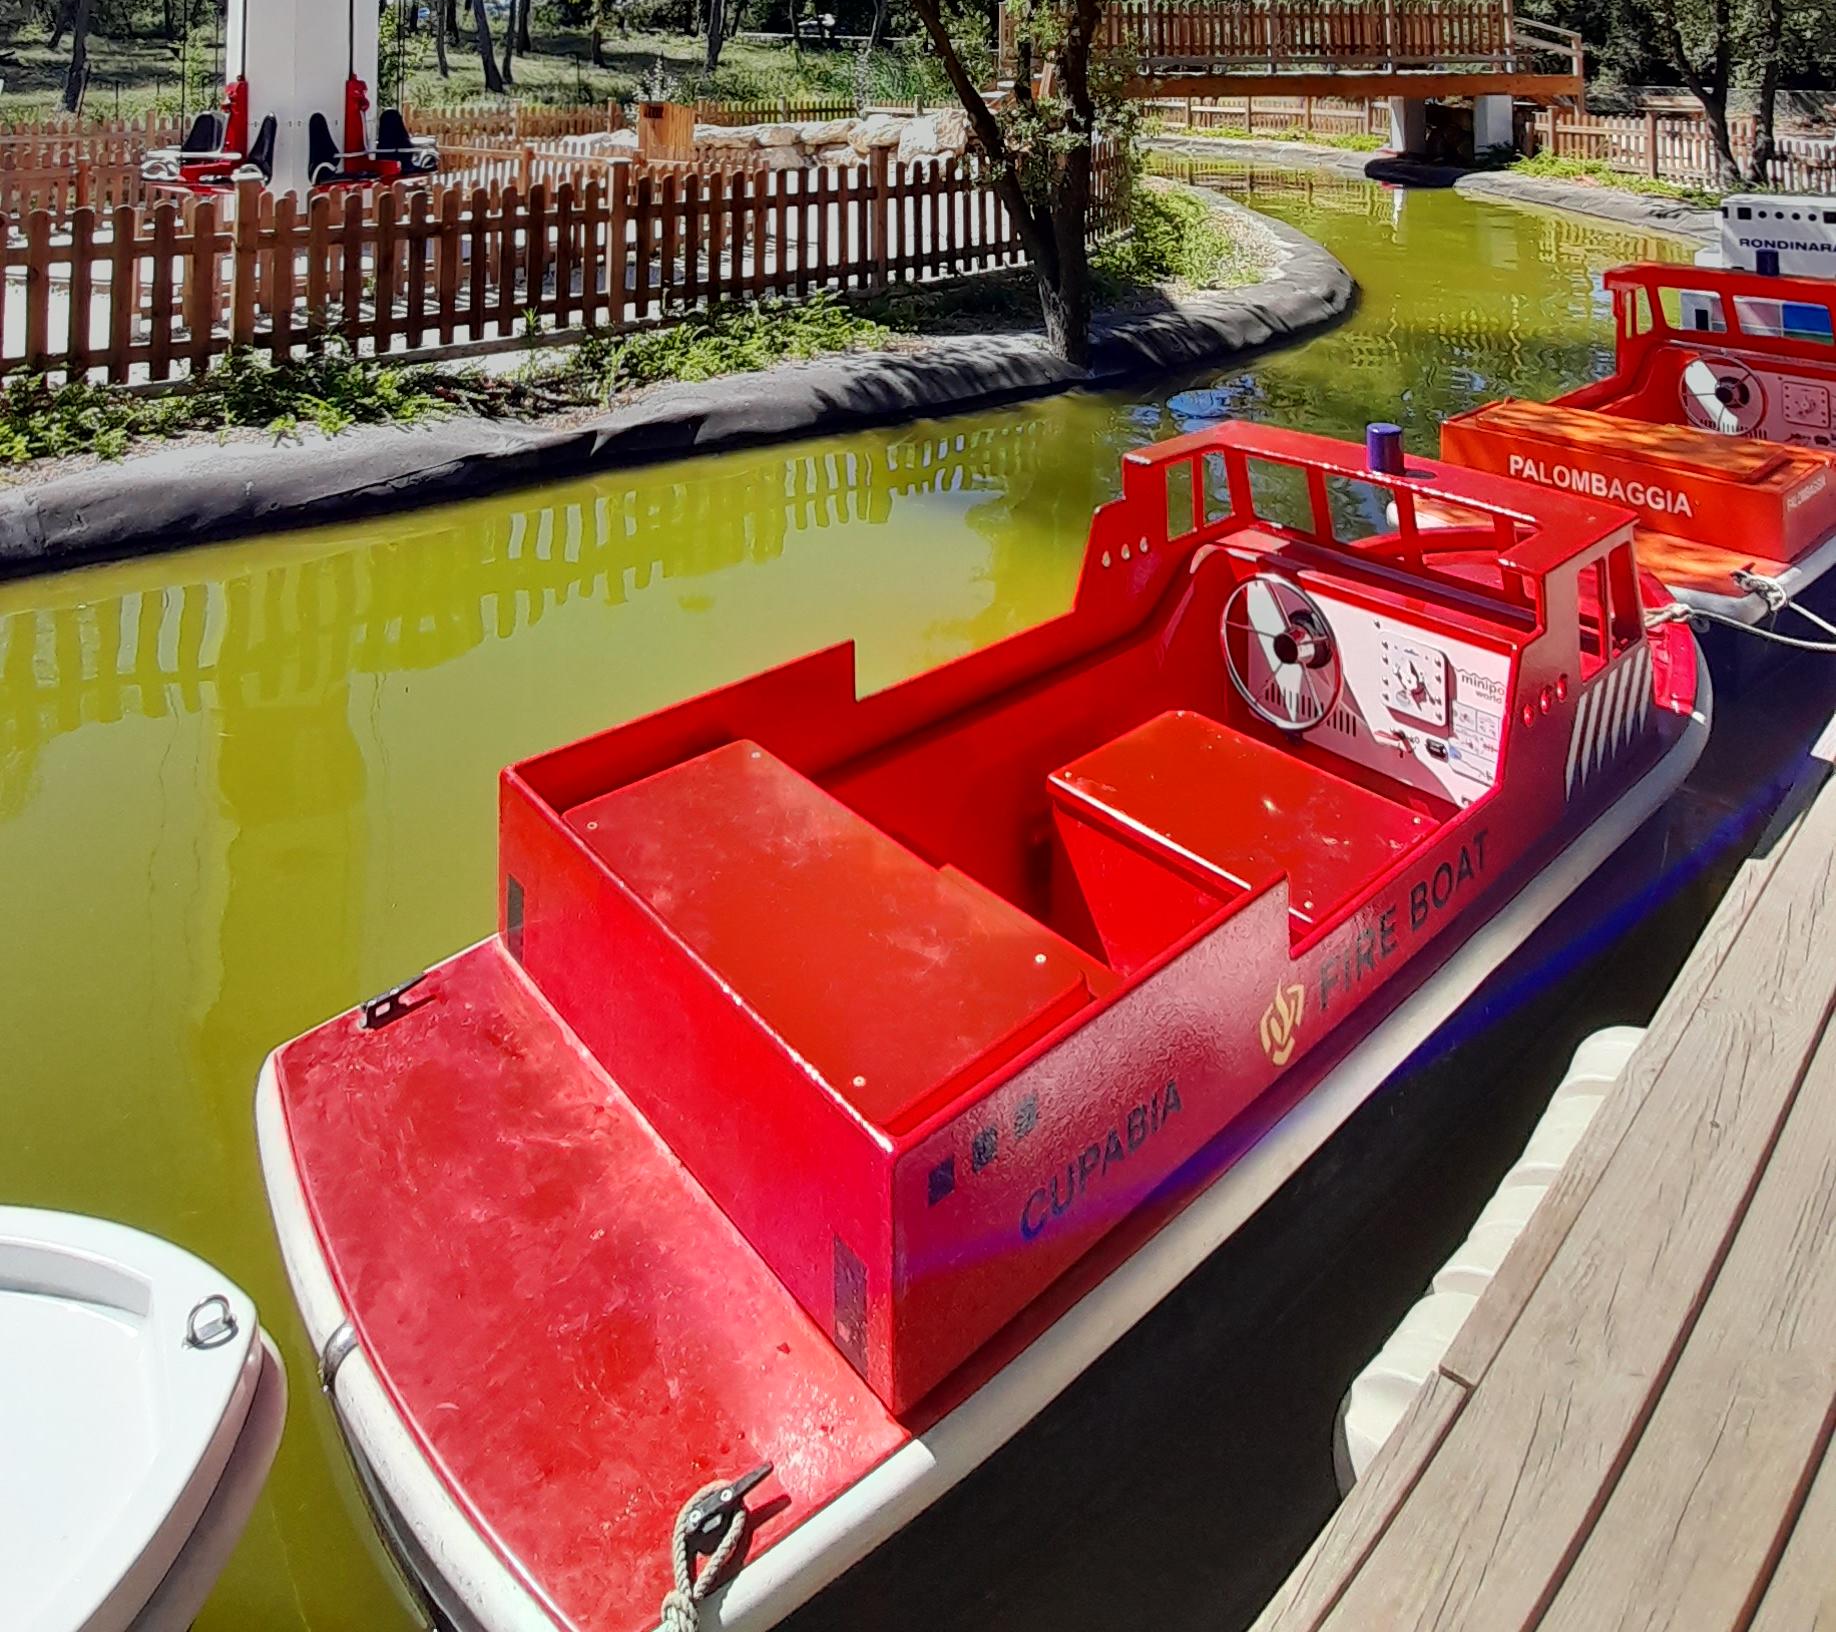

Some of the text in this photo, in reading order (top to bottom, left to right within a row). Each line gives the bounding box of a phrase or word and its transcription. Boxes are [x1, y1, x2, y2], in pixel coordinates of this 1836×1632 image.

[1739, 238, 1836, 253] RONDINAR
[1509, 454, 1693, 517] PALOMBAGGIA
[1319, 830, 1488, 1010] FIRE BOAT
[1019, 1080, 1182, 1242] CUPABIA
